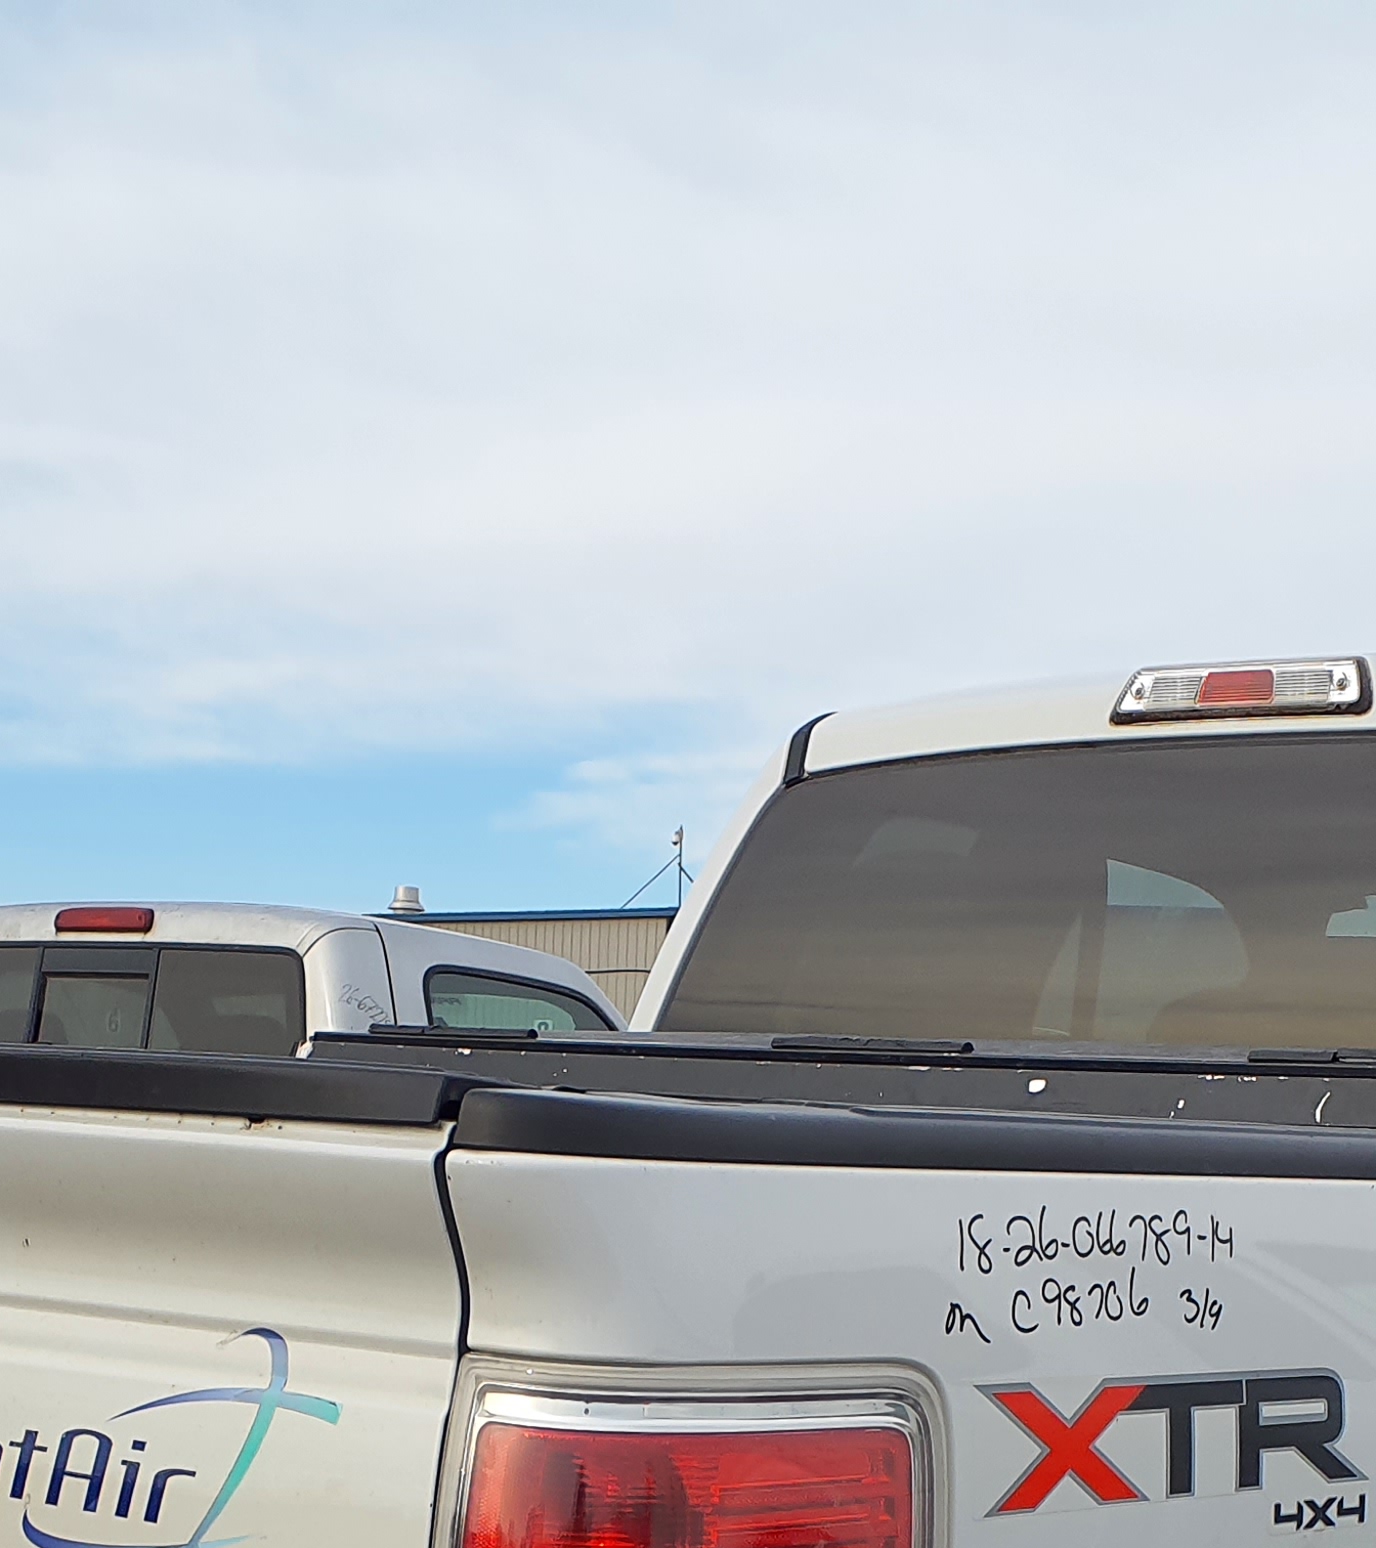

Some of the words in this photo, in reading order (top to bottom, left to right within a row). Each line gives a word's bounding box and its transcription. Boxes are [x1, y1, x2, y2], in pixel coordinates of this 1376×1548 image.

[957, 1205, 1234, 1275] 18-26-066789-14
[1179, 1287, 1224, 1331] 3/9
[974, 1368, 1369, 1517] XTR
